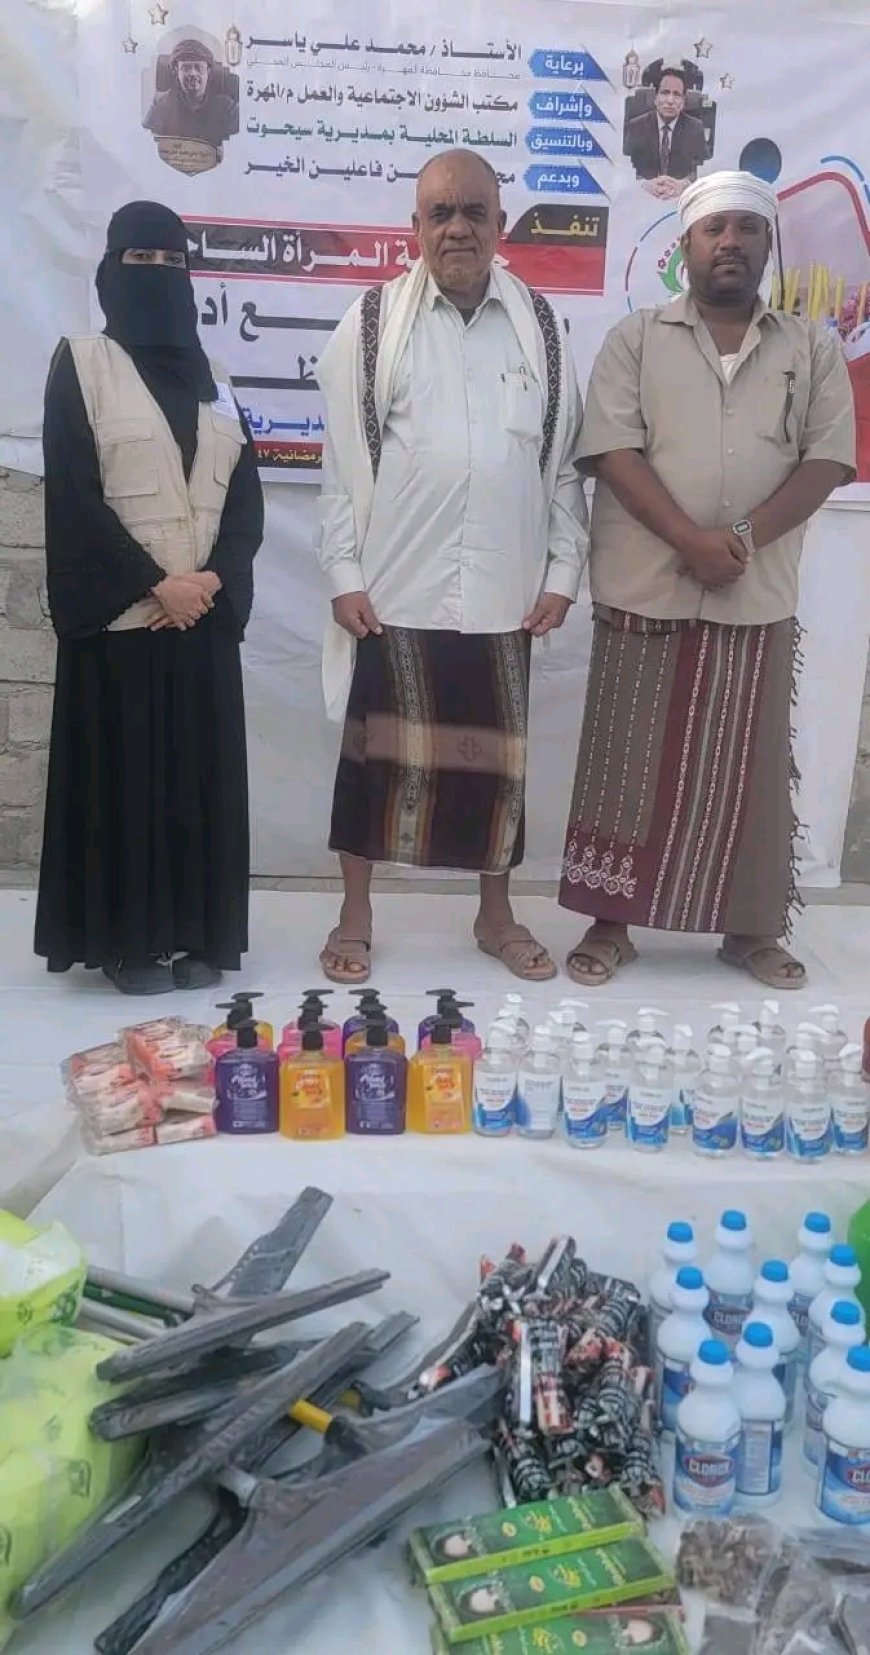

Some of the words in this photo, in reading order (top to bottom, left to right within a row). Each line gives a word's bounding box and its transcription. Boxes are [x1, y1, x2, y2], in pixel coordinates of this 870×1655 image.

[246, 31, 307, 53] ياسر
[310, 33, 360, 56] علي
[365, 38, 426, 56] محمد
[441, 39, 522, 60] الأستاذ
[544, 54, 585, 76] برعاية
[297, 83, 344, 106] والعمل
[347, 85, 421, 110] الاجتماعية
[424, 90, 469, 112] الشؤون
[472, 94, 519, 114] مكتب
[536, 94, 593, 118] وإشراف
[246, 116, 312, 141] سيحوت
[317, 119, 396, 145] بمديرية
[399, 124, 459, 147] المحلية
[462, 128, 518, 147] السلطة
[530, 133, 593, 151] وبالتنسيق
[243, 155, 305, 177] الخير
[308, 156, 383, 180] فاعلين
[536, 170, 580, 189] وبدعم
[530, 211, 600, 237] تنفذ
[282, 229, 389, 272] المرأة
[242, 407, 325, 436] ديرية
[688, 1459, 731, 1477] CLOROX
